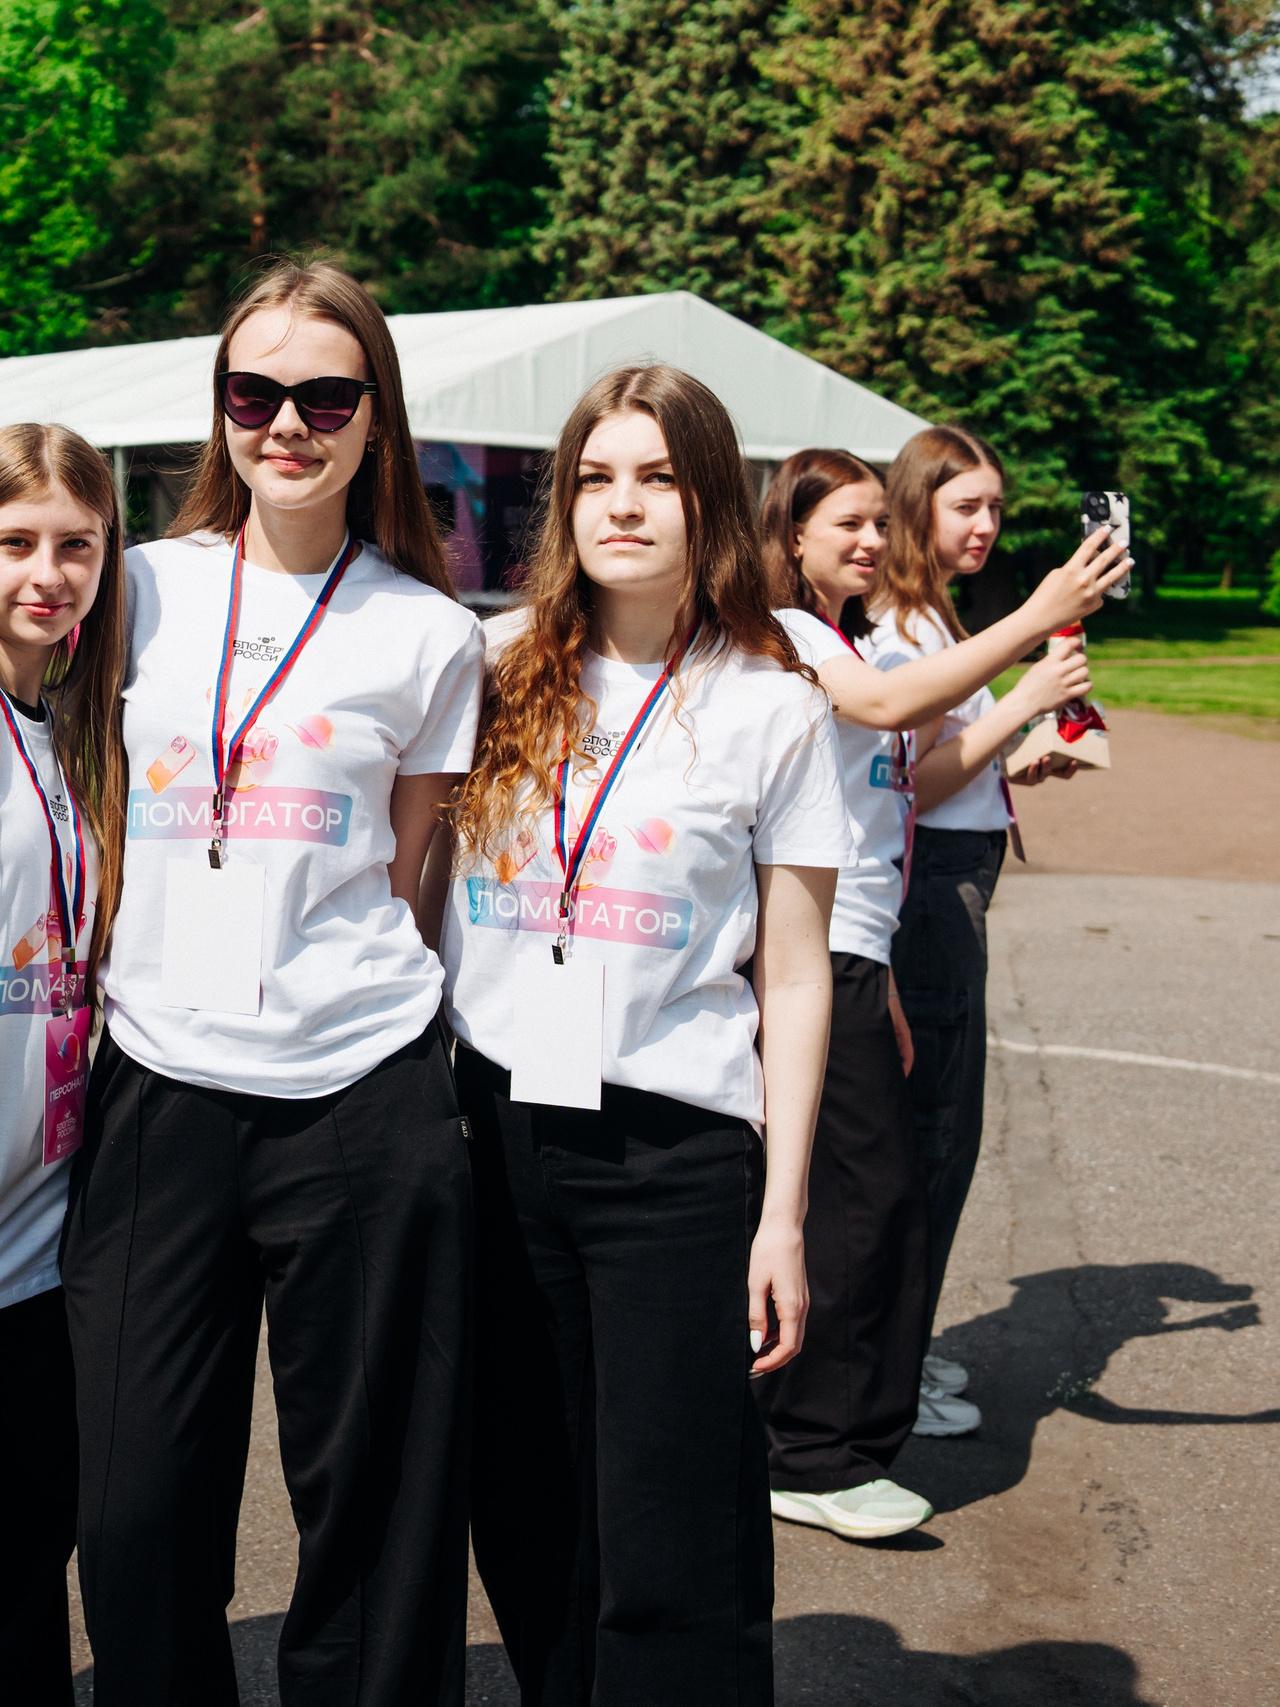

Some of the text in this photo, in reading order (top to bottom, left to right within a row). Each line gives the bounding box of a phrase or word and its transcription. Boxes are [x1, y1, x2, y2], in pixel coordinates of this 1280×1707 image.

[233, 639, 284, 654] БЛОГЕР
[234, 649, 279, 662] РОССИ
[132, 801, 343, 832] ПОМОГАТОР
[477, 890, 682, 936] ПОМОГАТОР
[49, 1074, 85, 1103] ПЕРСОНАЛ
